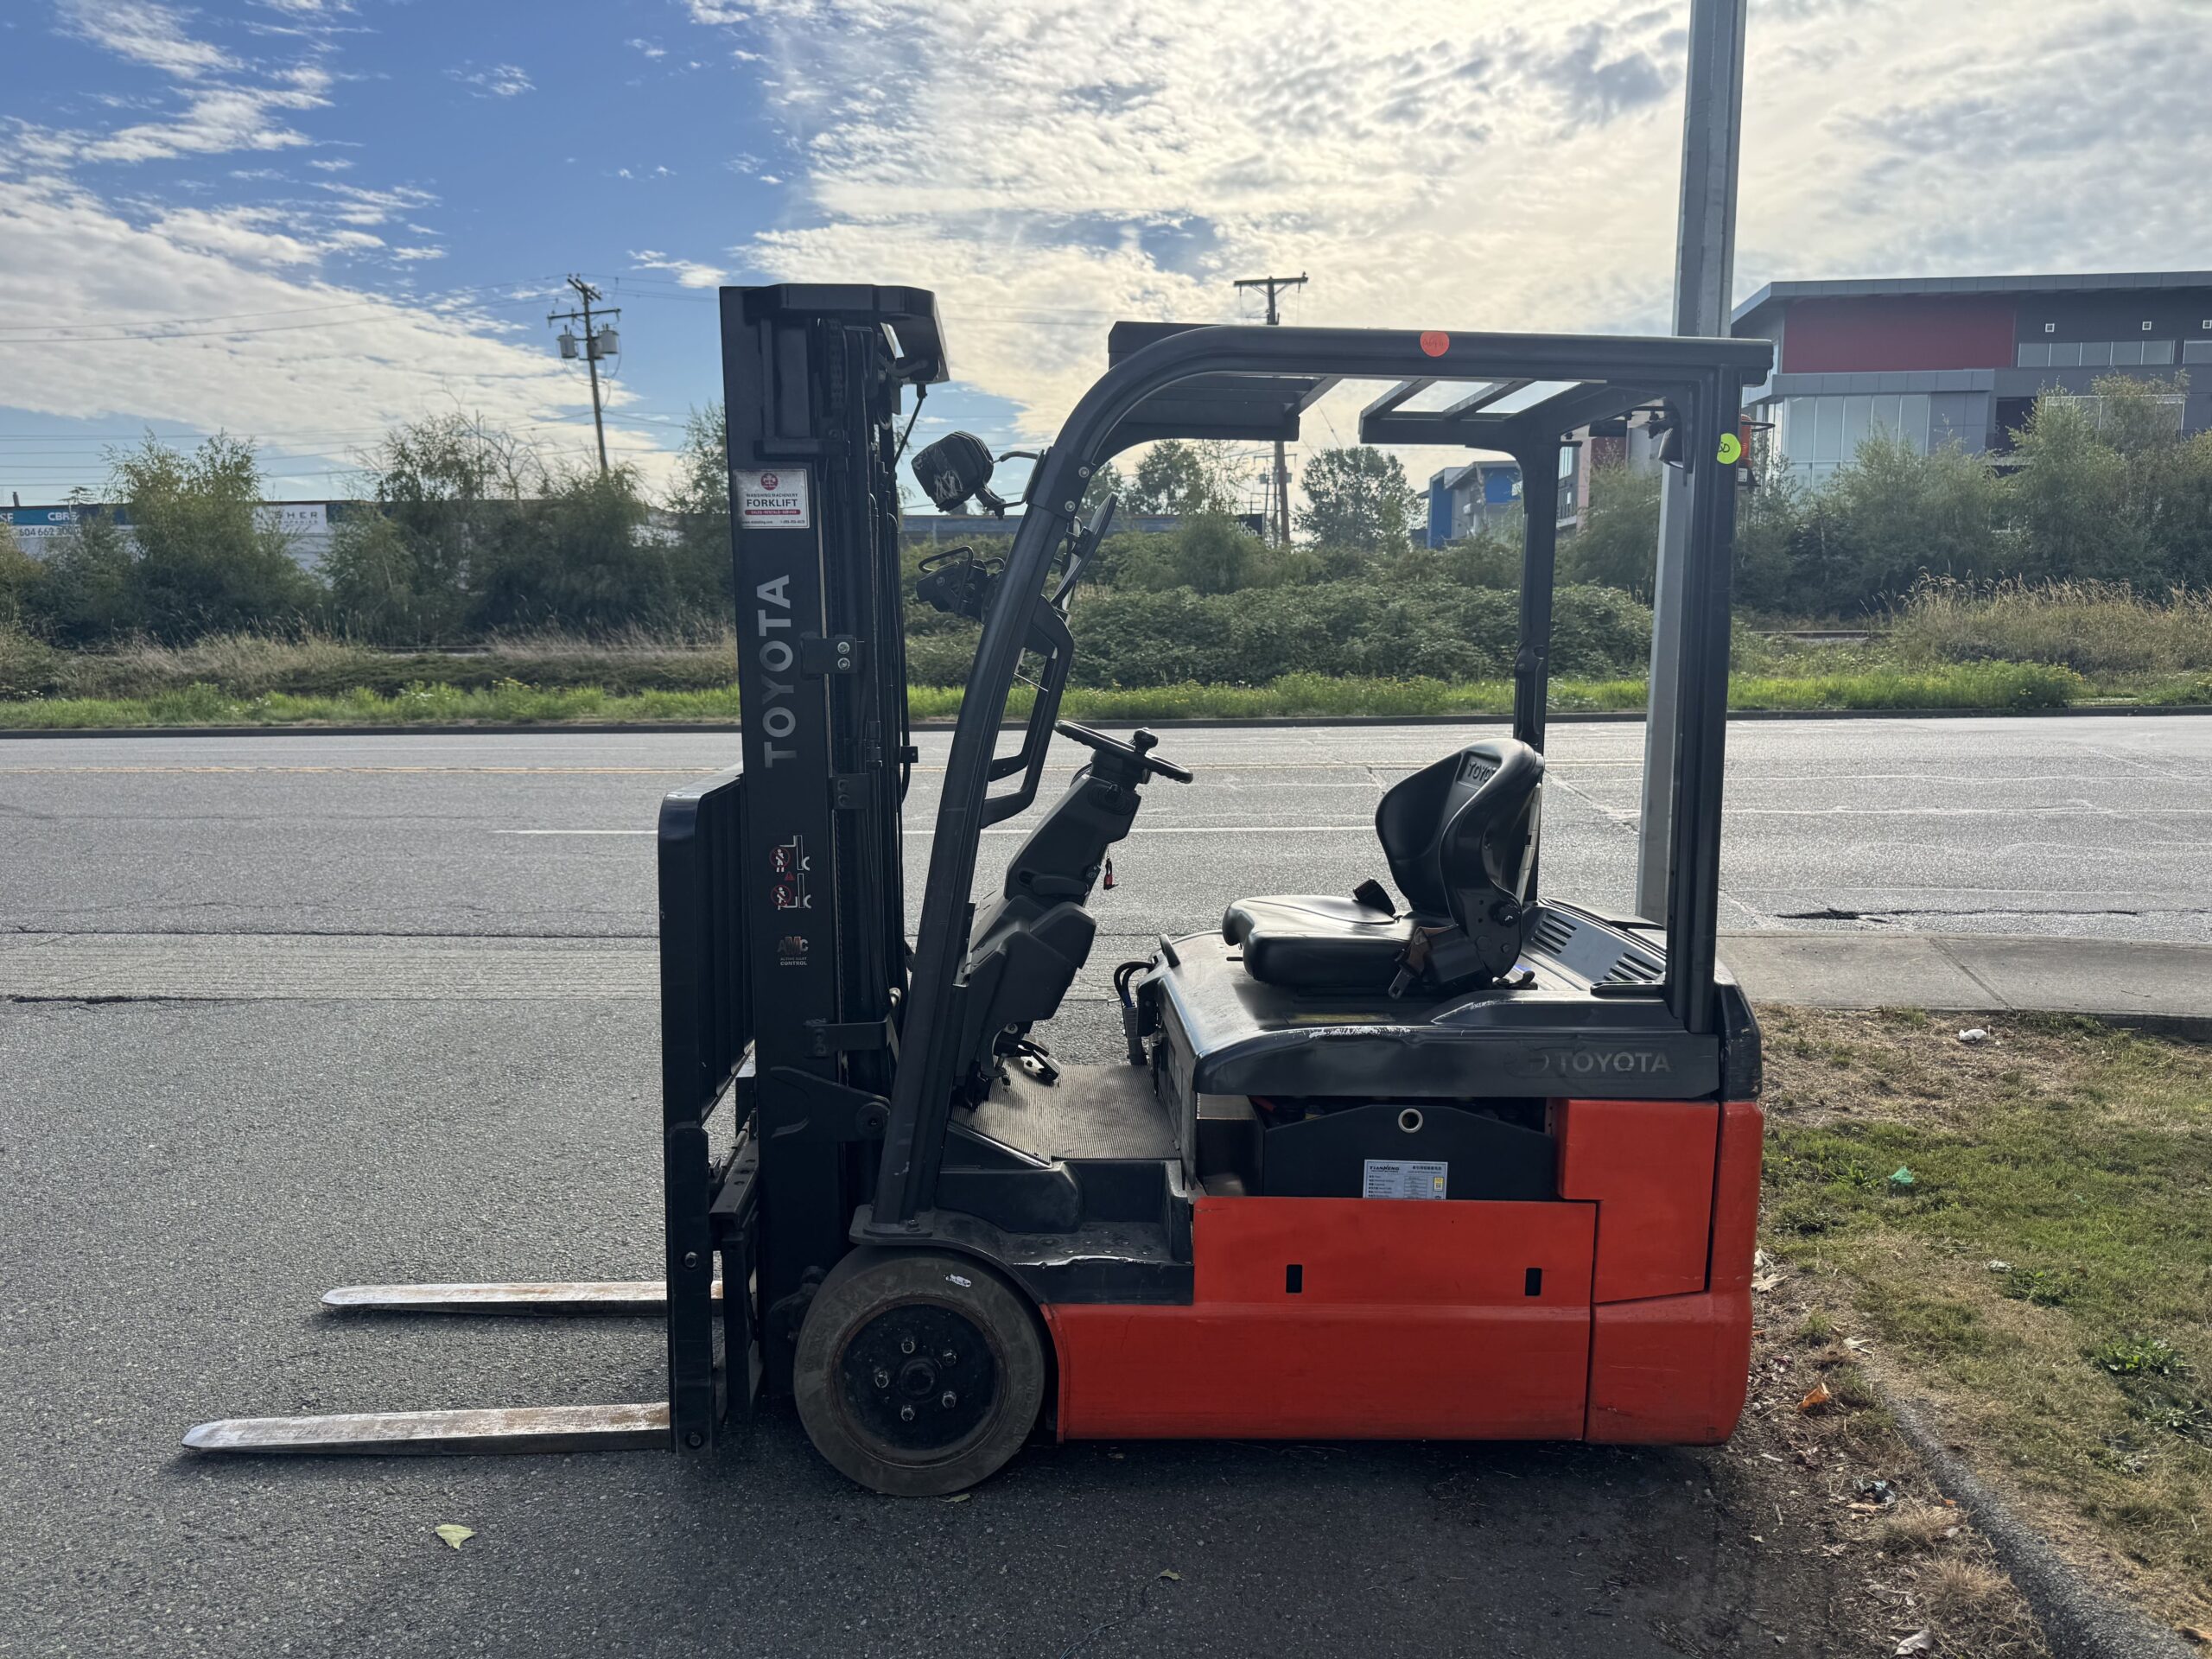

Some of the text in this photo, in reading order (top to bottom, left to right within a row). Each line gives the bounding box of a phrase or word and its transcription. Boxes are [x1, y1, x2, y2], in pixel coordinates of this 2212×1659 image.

[747, 499, 798, 507] FORKLIFT
[38, 527, 54, 536] 662
[757, 574, 797, 768] TOYOTA
[779, 936, 809, 954] AMC
[1560, 1052, 1672, 1073] TOYOTA
